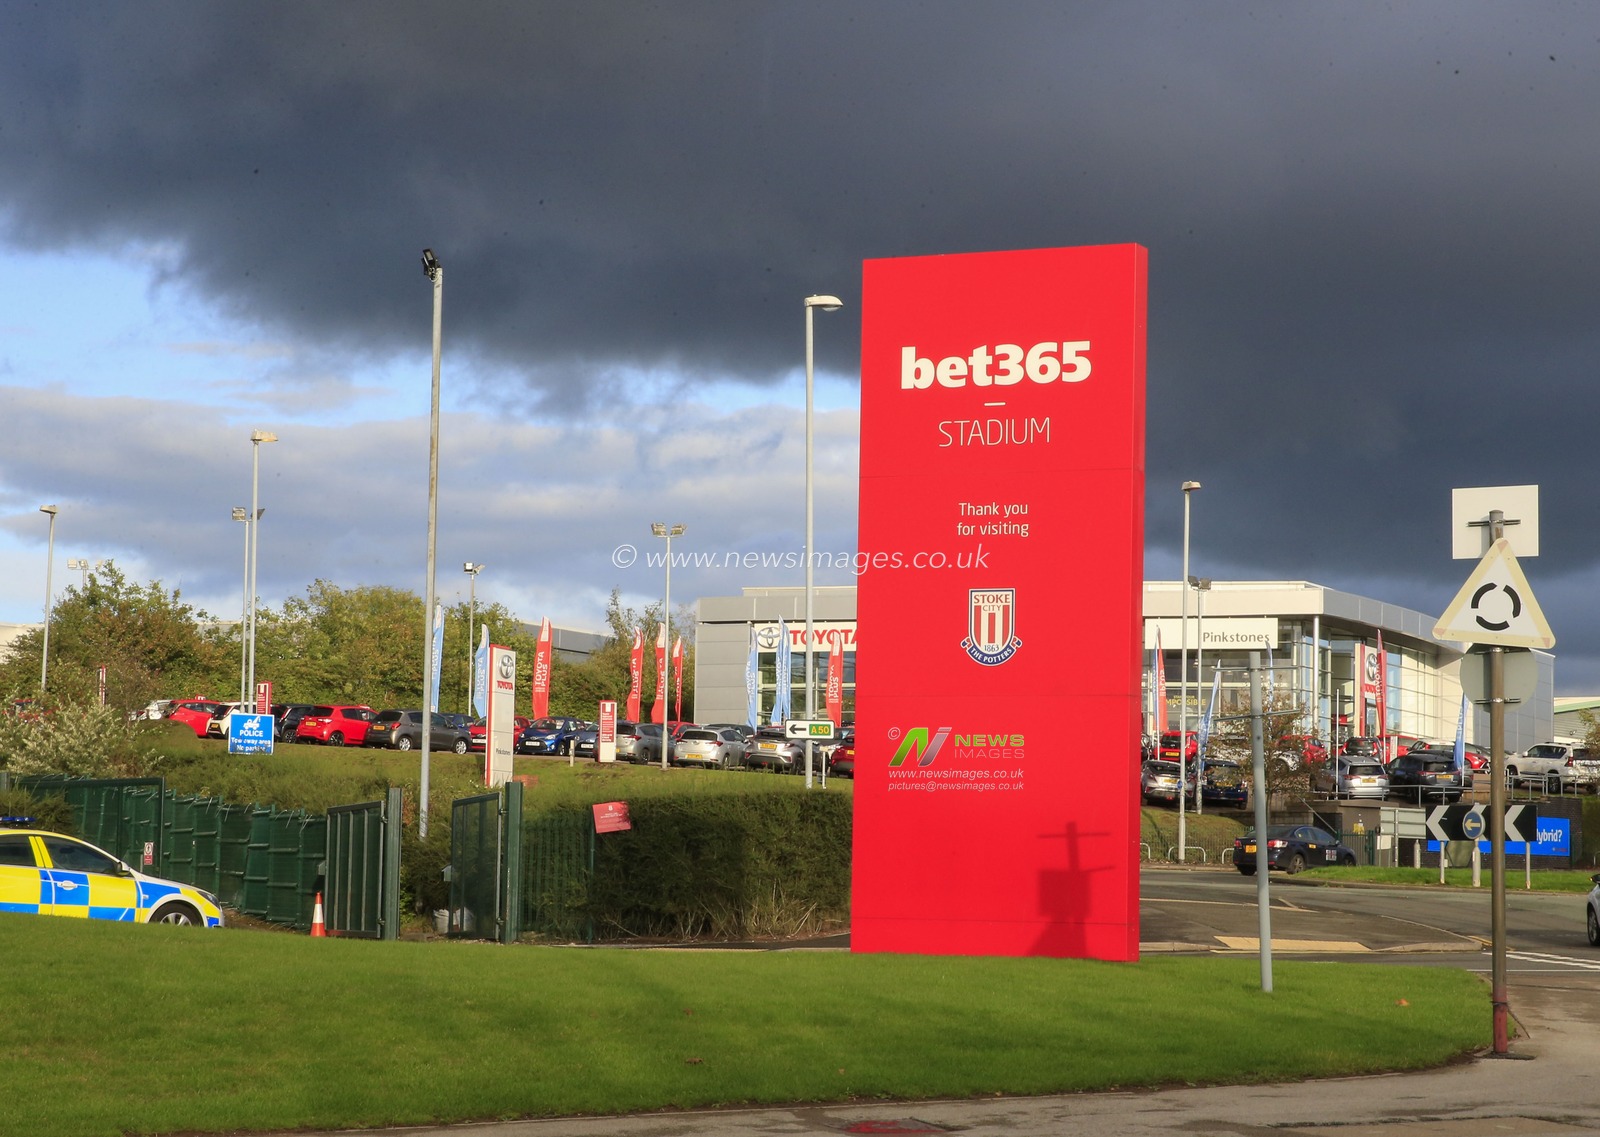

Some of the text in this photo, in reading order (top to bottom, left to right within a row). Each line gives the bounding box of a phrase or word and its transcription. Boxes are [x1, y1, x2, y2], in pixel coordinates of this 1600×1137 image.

[901, 340, 1092, 390] bet365
[938, 416, 1050, 447] STADIUM
[958, 502, 1029, 518] Thank you
[956, 521, 1029, 537] for visiting
[973, 593, 1010, 604] STOKE
[982, 604, 1002, 612] CITY
[1202, 632, 1270, 643] Pinkstones
[970, 646, 1012, 663] THE POTTERS
[984, 644, 999, 653] 1863
[535, 651, 545, 686] TOYOTA
[540, 664, 548, 687] PLUS
[497, 680, 514, 691] TOYOTA
[239, 729, 264, 738] POLICE
